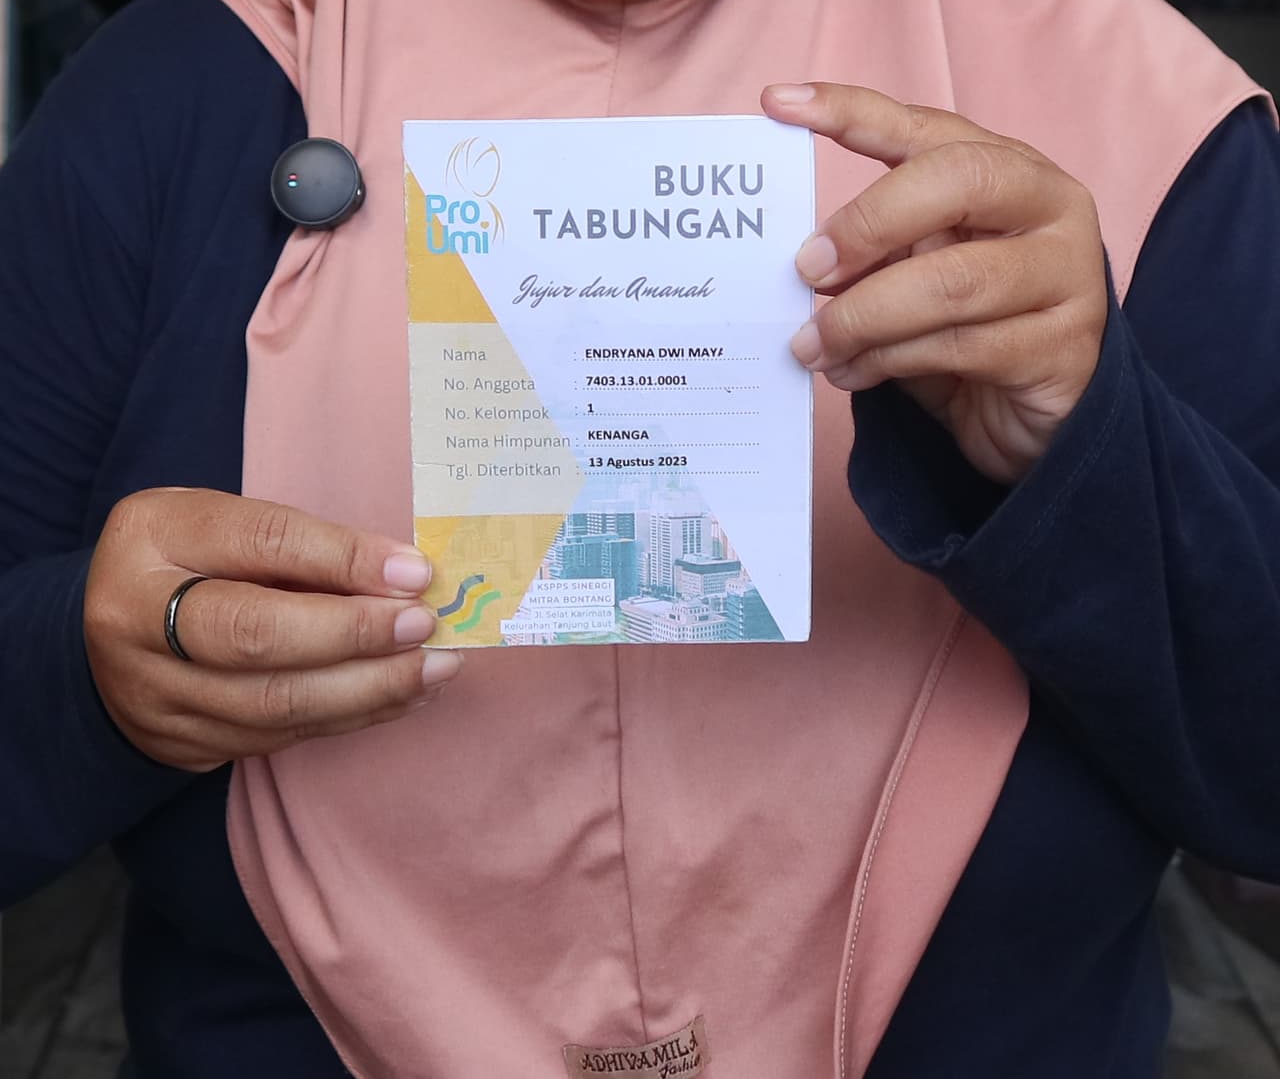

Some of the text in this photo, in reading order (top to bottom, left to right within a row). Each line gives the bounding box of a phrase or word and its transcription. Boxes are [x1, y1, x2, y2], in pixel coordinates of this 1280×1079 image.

[654, 164, 764, 196] BUKU
[425, 194, 480, 224] Pro
[533, 208, 764, 240] TABUNGAN
[426, 222, 489, 254] Umi
[512, 274, 716, 309] Jujur dan Amanah
[443, 349, 486, 361] Nama
[585, 348, 655, 359] ENDRYANA
[658, 348, 685, 358] DWI
[444, 376, 687, 394] No. Anggota 7403.13.01.0001
[445, 403, 595, 422] No. Kelompok 1
[446, 430, 649, 451] Nama Himpunan KENANGA
[447, 456, 688, 480] Tgl. Diterbitkan 13 Agustus 2023
[537, 582, 612, 591] KSPPS SINERGI
[529, 595, 612, 604] MITRA BONTANG
[504, 620, 612, 631] Kelurahan Tanjung Laut
